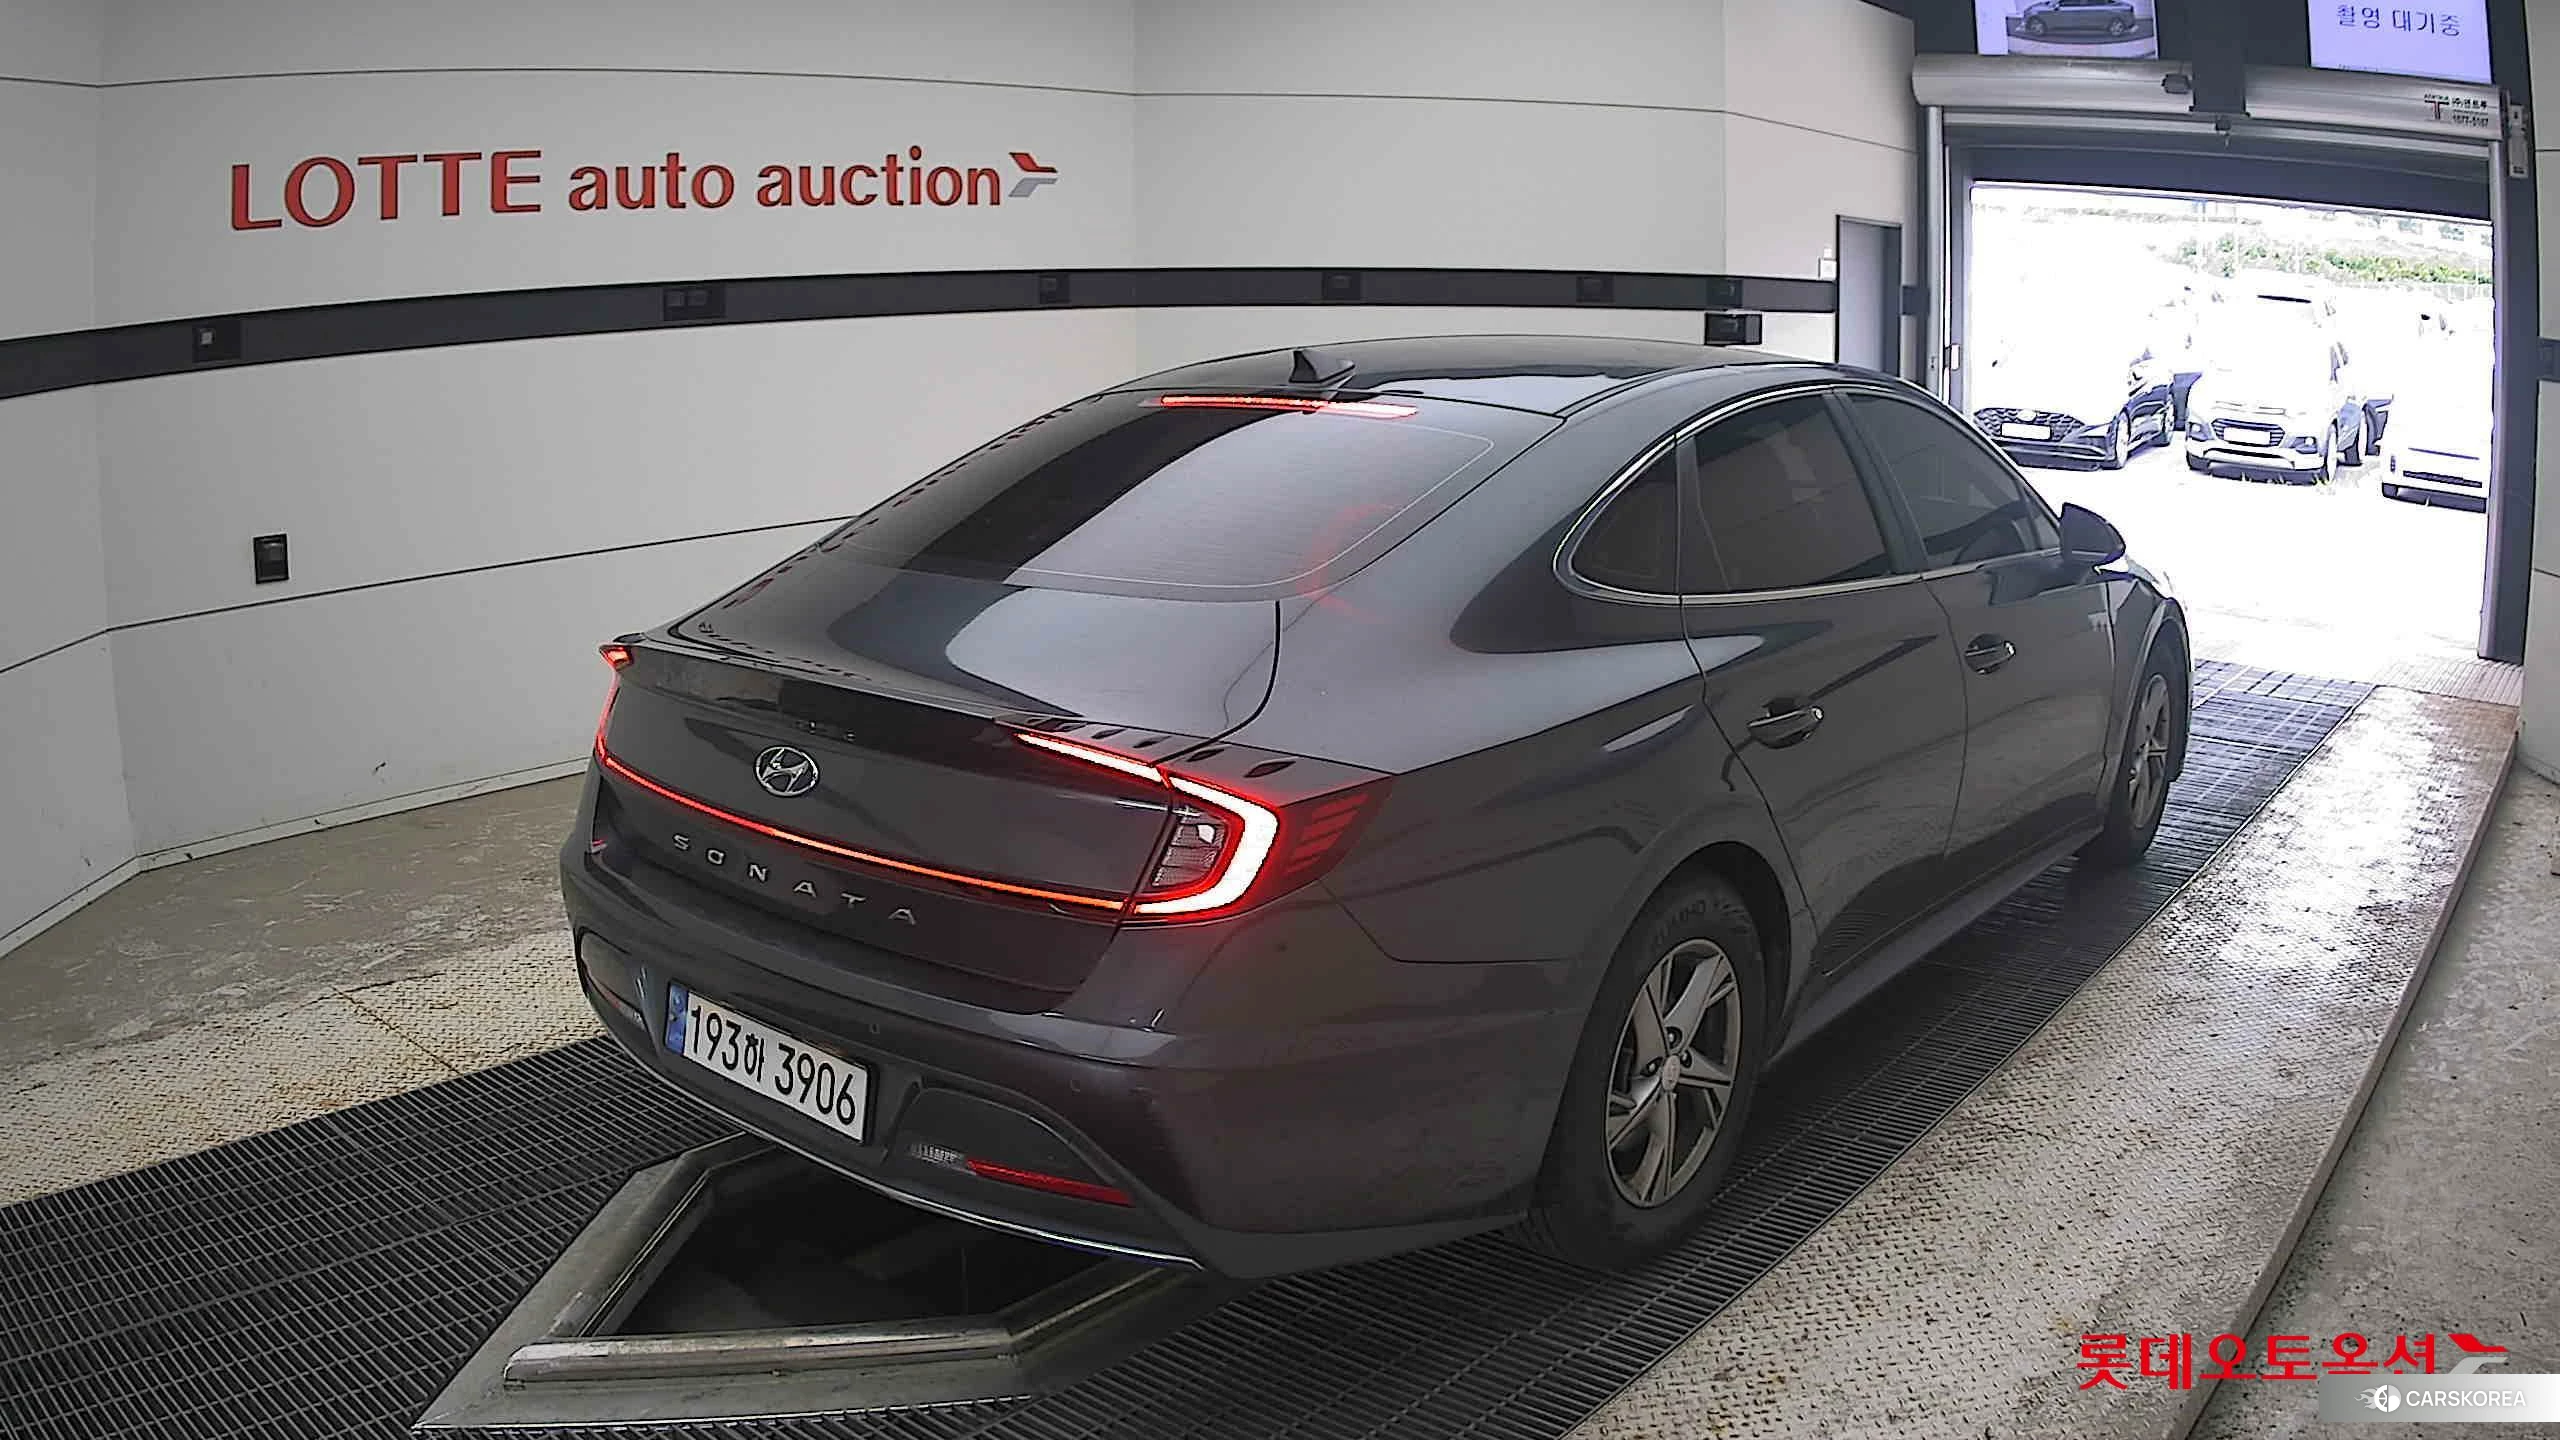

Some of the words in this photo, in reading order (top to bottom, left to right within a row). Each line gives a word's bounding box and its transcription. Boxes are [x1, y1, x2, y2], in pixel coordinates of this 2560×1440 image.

[2337, 4, 2380, 29] 촬영
[2392, 9, 2461, 37] 대기중
[231, 150, 541, 231] LOTTE
[568, 153, 735, 210] auto
[756, 147, 1001, 207] auction
[672, 833, 917, 926] SONATA
[691, 1005, 764, 1083] 193하
[775, 1042, 856, 1126] 3906
